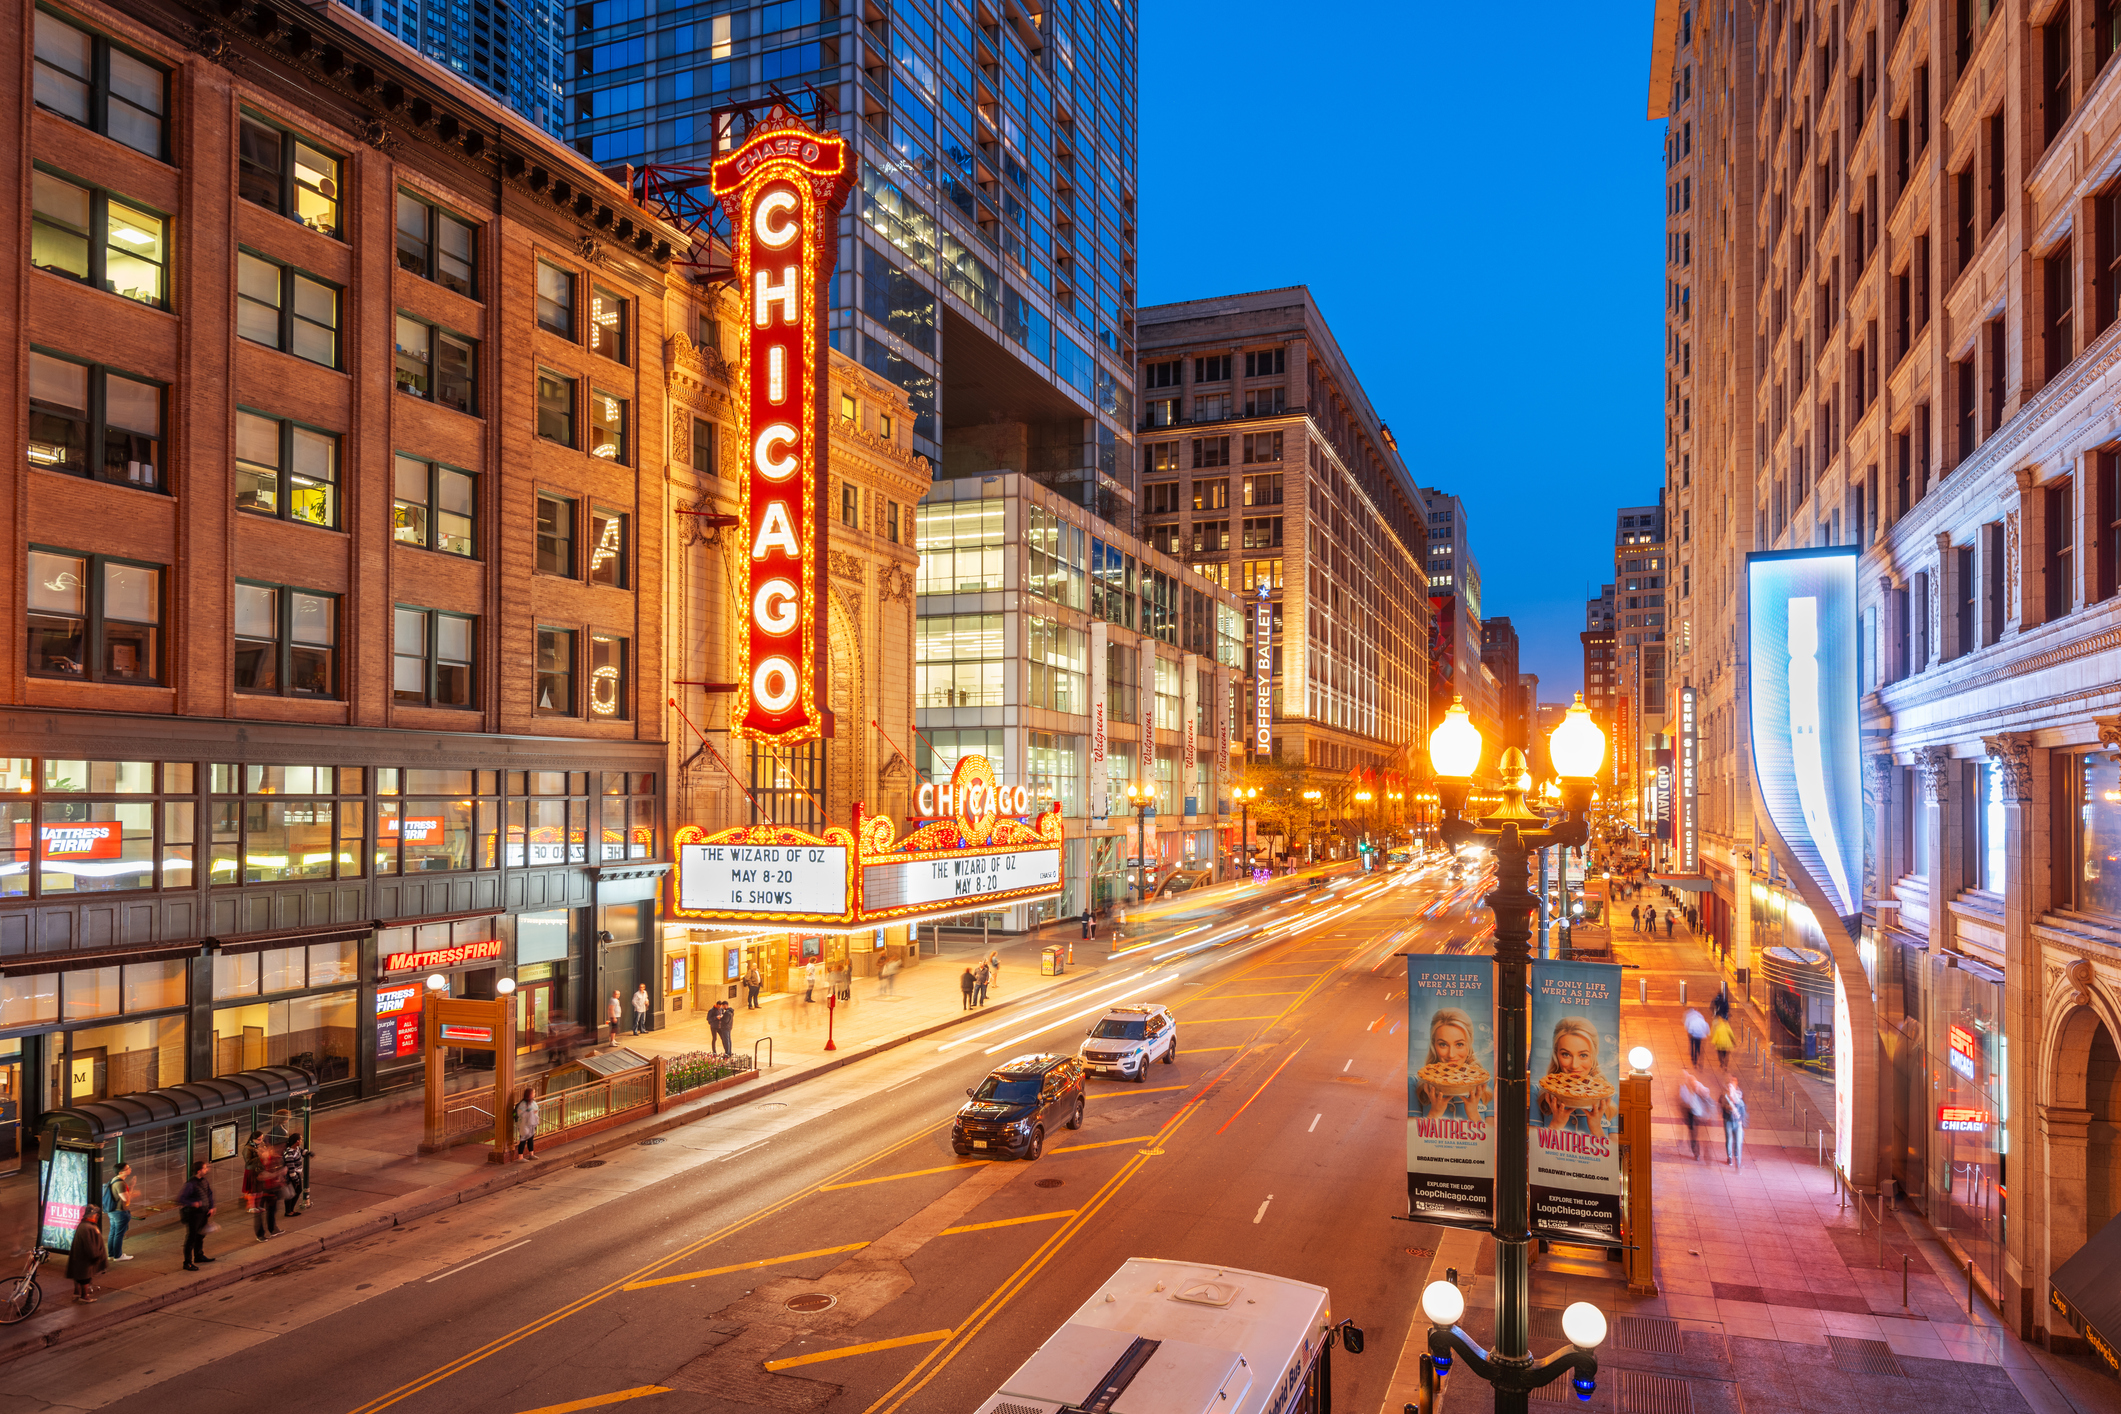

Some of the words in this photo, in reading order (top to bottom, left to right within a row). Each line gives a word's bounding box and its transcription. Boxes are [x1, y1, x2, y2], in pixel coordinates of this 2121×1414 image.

[736, 139, 801, 175] CHASE
[752, 187, 802, 716] CHICAGO
[1257, 606, 1270, 669] BALLET
[1257, 675, 1270, 752] JOFFREY
[1683, 692, 1692, 732] GENE
[1094, 702, 1107, 763] Walgreens
[1143, 711, 1155, 766] Walgreens
[1185, 719, 1196, 769] Walgreens
[1219, 726, 1229, 772] Walgreens
[1657, 765, 1670, 789] OLD
[1683, 738, 1693, 798] SISKEL
[915, 782, 1028, 816] CHICAGO
[1657, 791, 1670, 822] NAVY
[388, 820, 437, 830] MTTRESS
[48, 839, 94, 852] FIRM
[701, 848, 724, 861] THE
[730, 848, 780, 862] WIZARD
[786, 849, 802, 862] OF
[809, 850, 825, 863] OZ
[1685, 831, 1693, 867] CENTER
[731, 869, 757, 883] MAY
[763, 870, 793, 883] 8-20
[932, 862, 948, 879] THE
[954, 858, 987, 876] WIZARD
[991, 857, 1001, 872] OF
[1005, 856, 1016, 870] OZ
[731, 890, 742, 903] 16
[749, 891, 793, 904] SHOWS
[955, 878, 971, 895] MAY
[976, 876, 998, 891] 8-20
[1432, 973, 1457, 981] ONLY
[1459, 982, 1482, 990] EASY
[1545, 979, 1554, 987] IF
[1585, 982, 1606, 991] LIFE
[1541, 987, 1567, 996] WERE
[1585, 991, 1609, 999] EASY
[377, 999, 405, 1013] FIRM
[378, 1020, 396, 1029] purple
[398, 1026, 418, 1035] BRANDS
[1950, 1047, 1974, 1079] CHICAGO
[73, 1072, 86, 1083] M
[1416, 1117, 1486, 1141] WAITRESS
[1537, 1127, 1610, 1157] WAITRESS
[1415, 1188, 1487, 1203] LoopChicago.com
[1427, 1181, 1449, 1189] EXPLORE
[50, 1205, 80, 1220] FLESH
[1536, 1203, 1613, 1218] LoopChicago.com
[1549, 1195, 1573, 1204] EXPLORE
[1584, 1199, 1599, 1207] LOOP
[2086, 1325, 2119, 1370] Sandwiches
[1289, 1359, 1301, 1392] Bus
